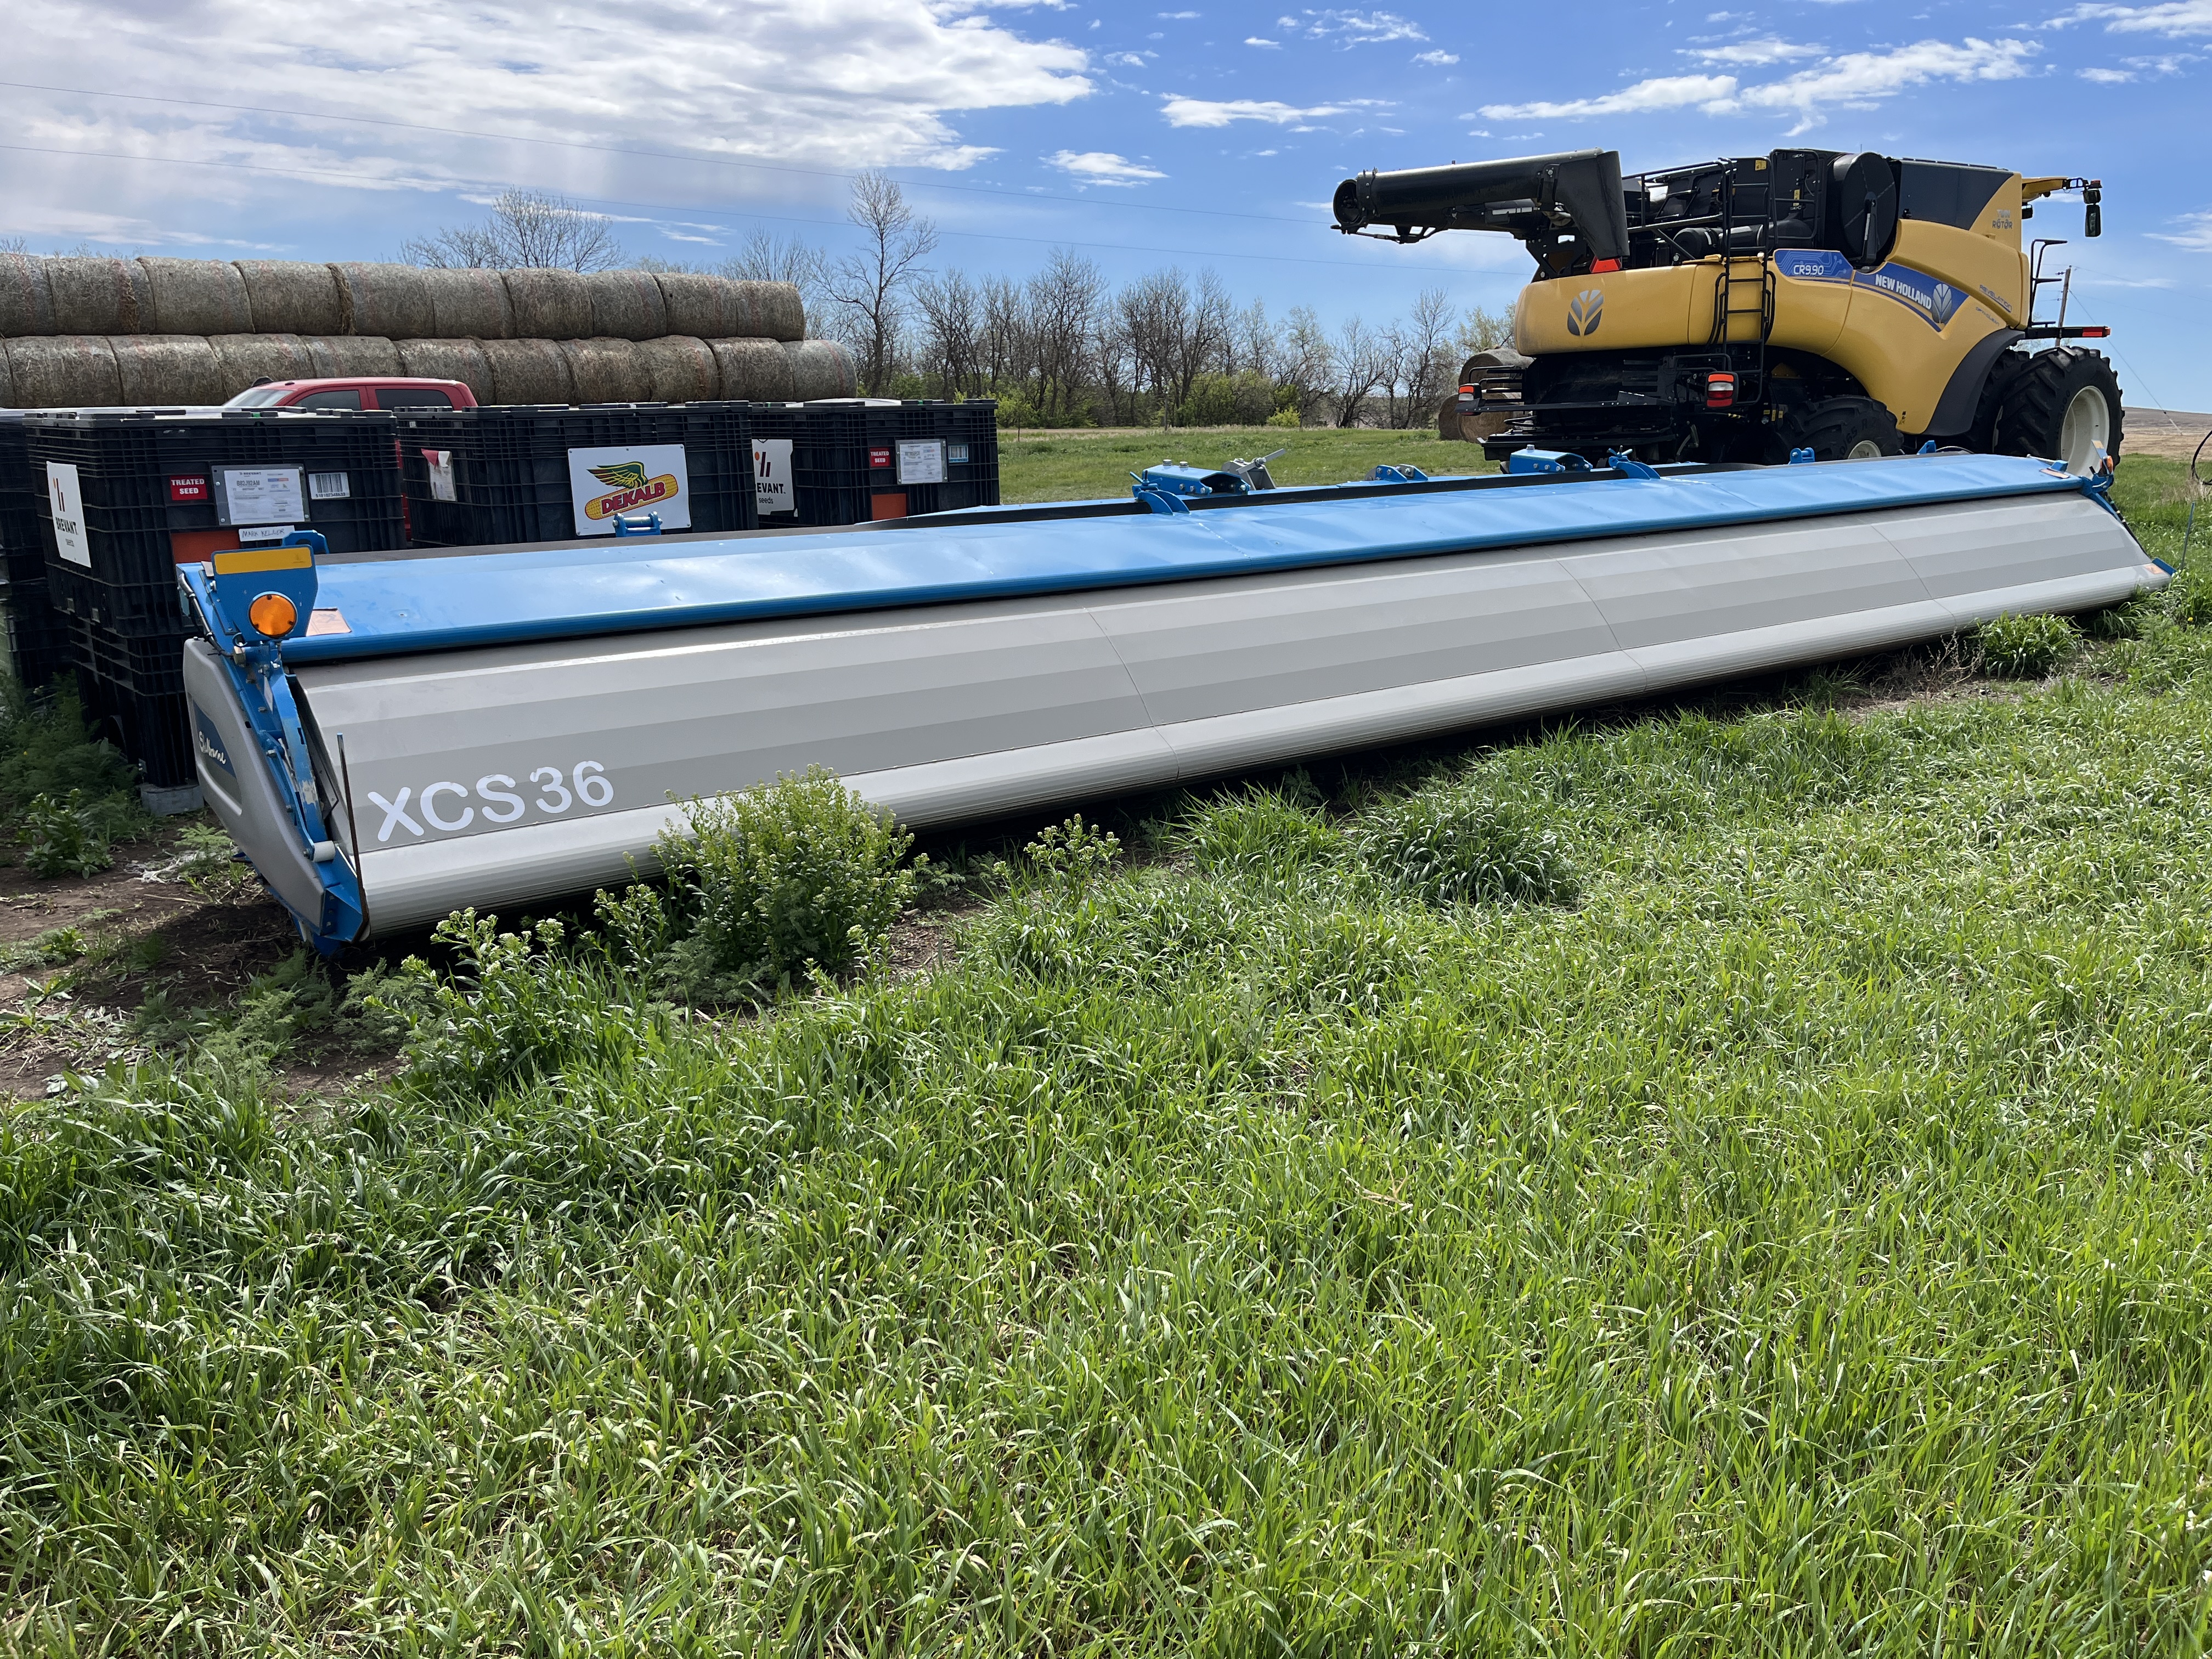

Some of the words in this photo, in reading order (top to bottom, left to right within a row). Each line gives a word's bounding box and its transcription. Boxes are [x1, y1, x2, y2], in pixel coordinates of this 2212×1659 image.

[1992, 219, 2012, 229] ROTOR
[1875, 274, 1896, 290] NEW
[1896, 281, 1932, 309] HOLLAND
[601, 482, 665, 515] DEKALB
[368, 760, 614, 842] XCS36
